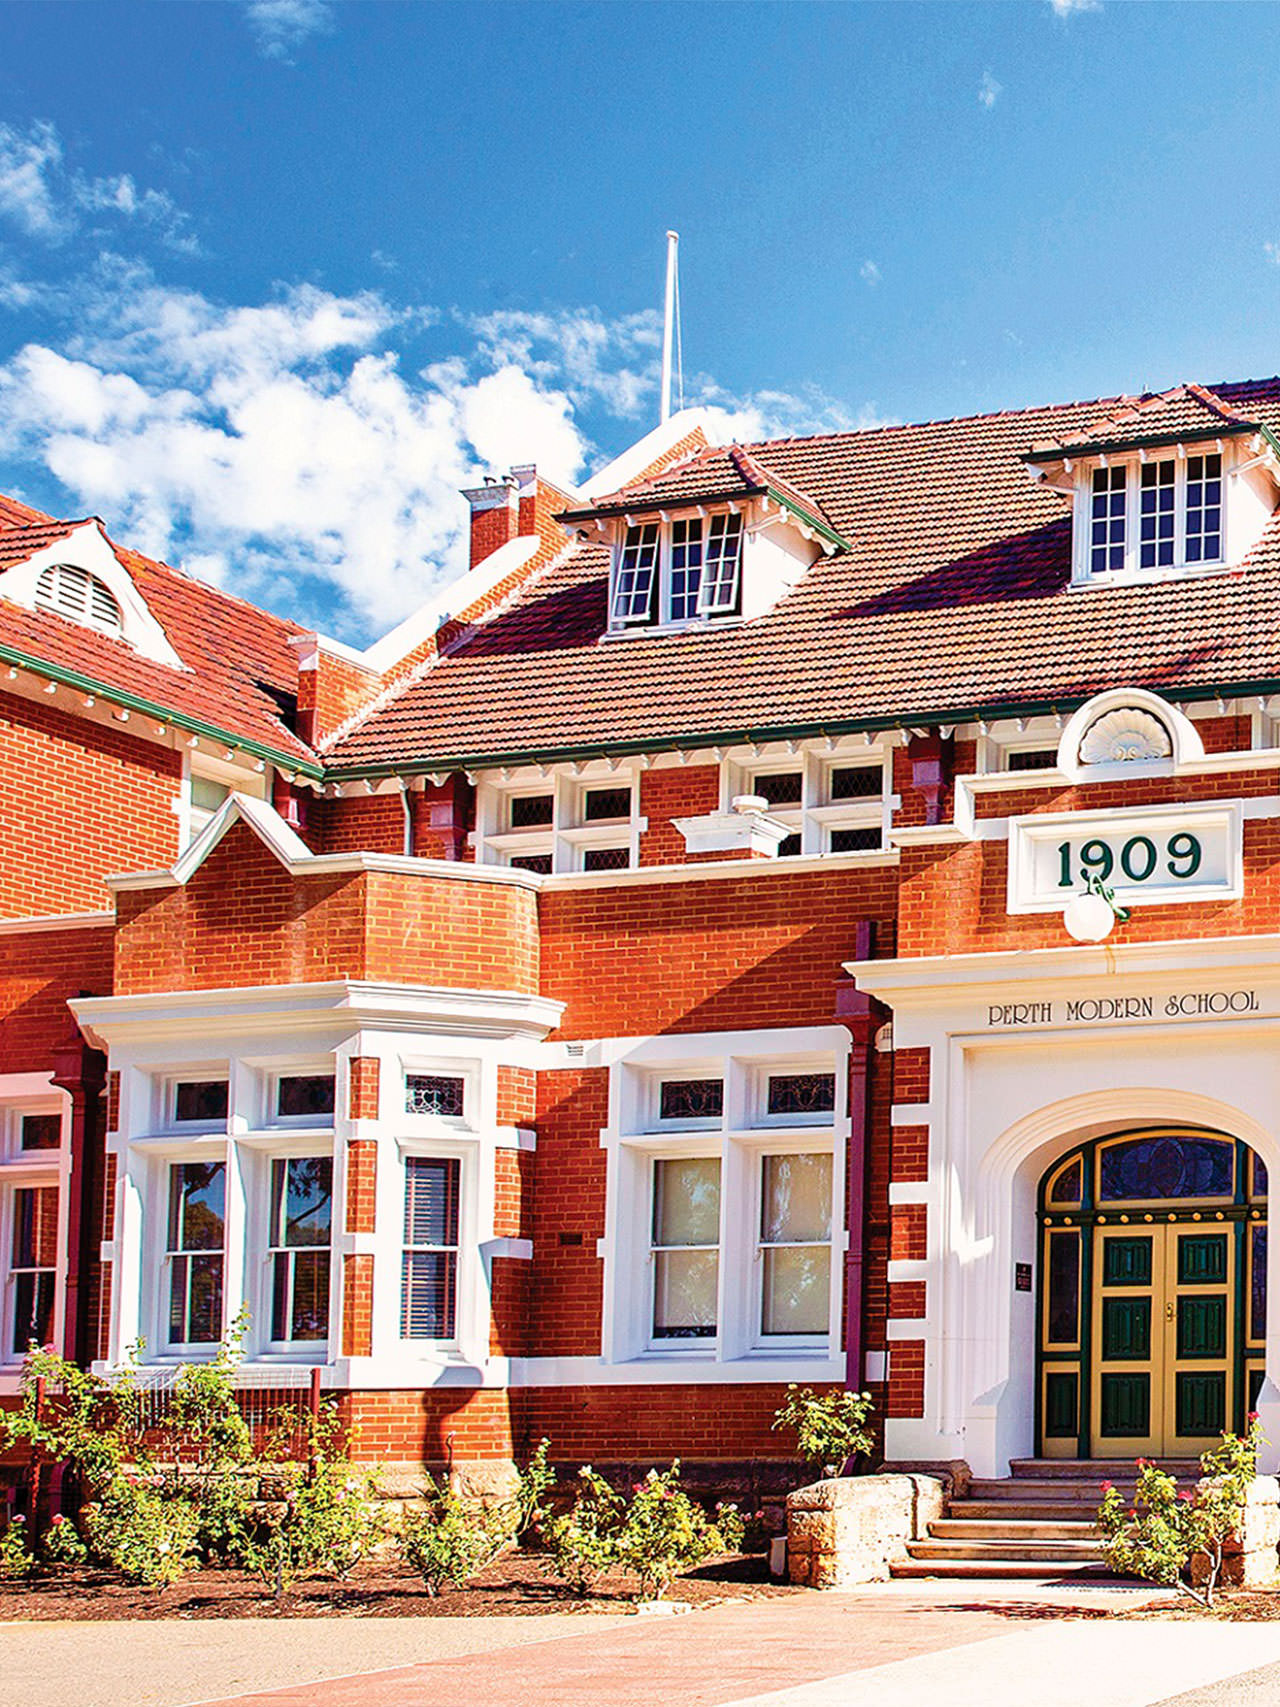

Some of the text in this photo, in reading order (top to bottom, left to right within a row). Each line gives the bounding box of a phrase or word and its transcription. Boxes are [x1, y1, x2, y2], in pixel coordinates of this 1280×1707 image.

[1058, 832, 1202, 887] 1909
[988, 990, 1259, 1026] PERTH MODERN SCHOOL
